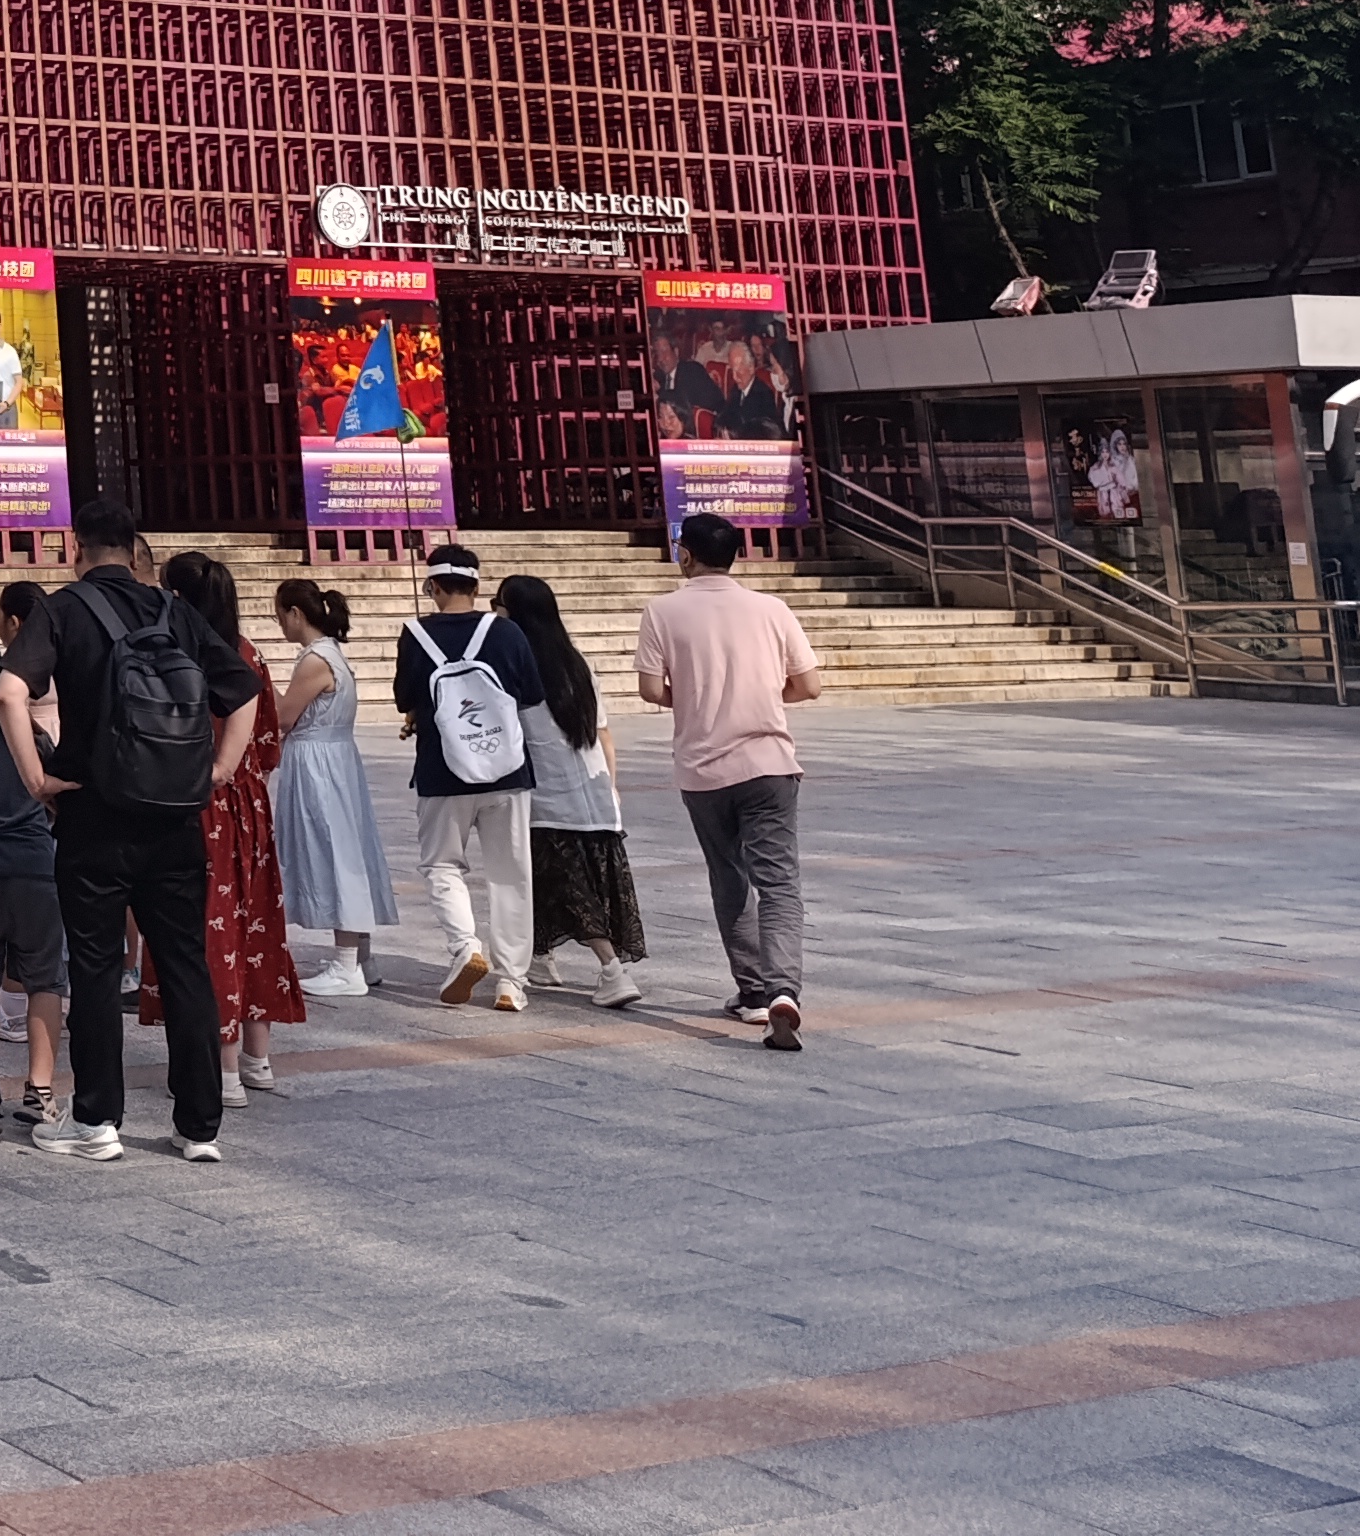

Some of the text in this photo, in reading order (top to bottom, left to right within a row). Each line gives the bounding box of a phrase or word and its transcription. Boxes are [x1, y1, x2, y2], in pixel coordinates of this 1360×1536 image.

[380, 185, 690, 217] TRUNG NGUYÊN LEGEND
[591, 221, 648, 232] CHANGES
[296, 268, 427, 288] 四川遂宁市杂技团
[656, 280, 773, 300] 四川遂宁市杂技团
